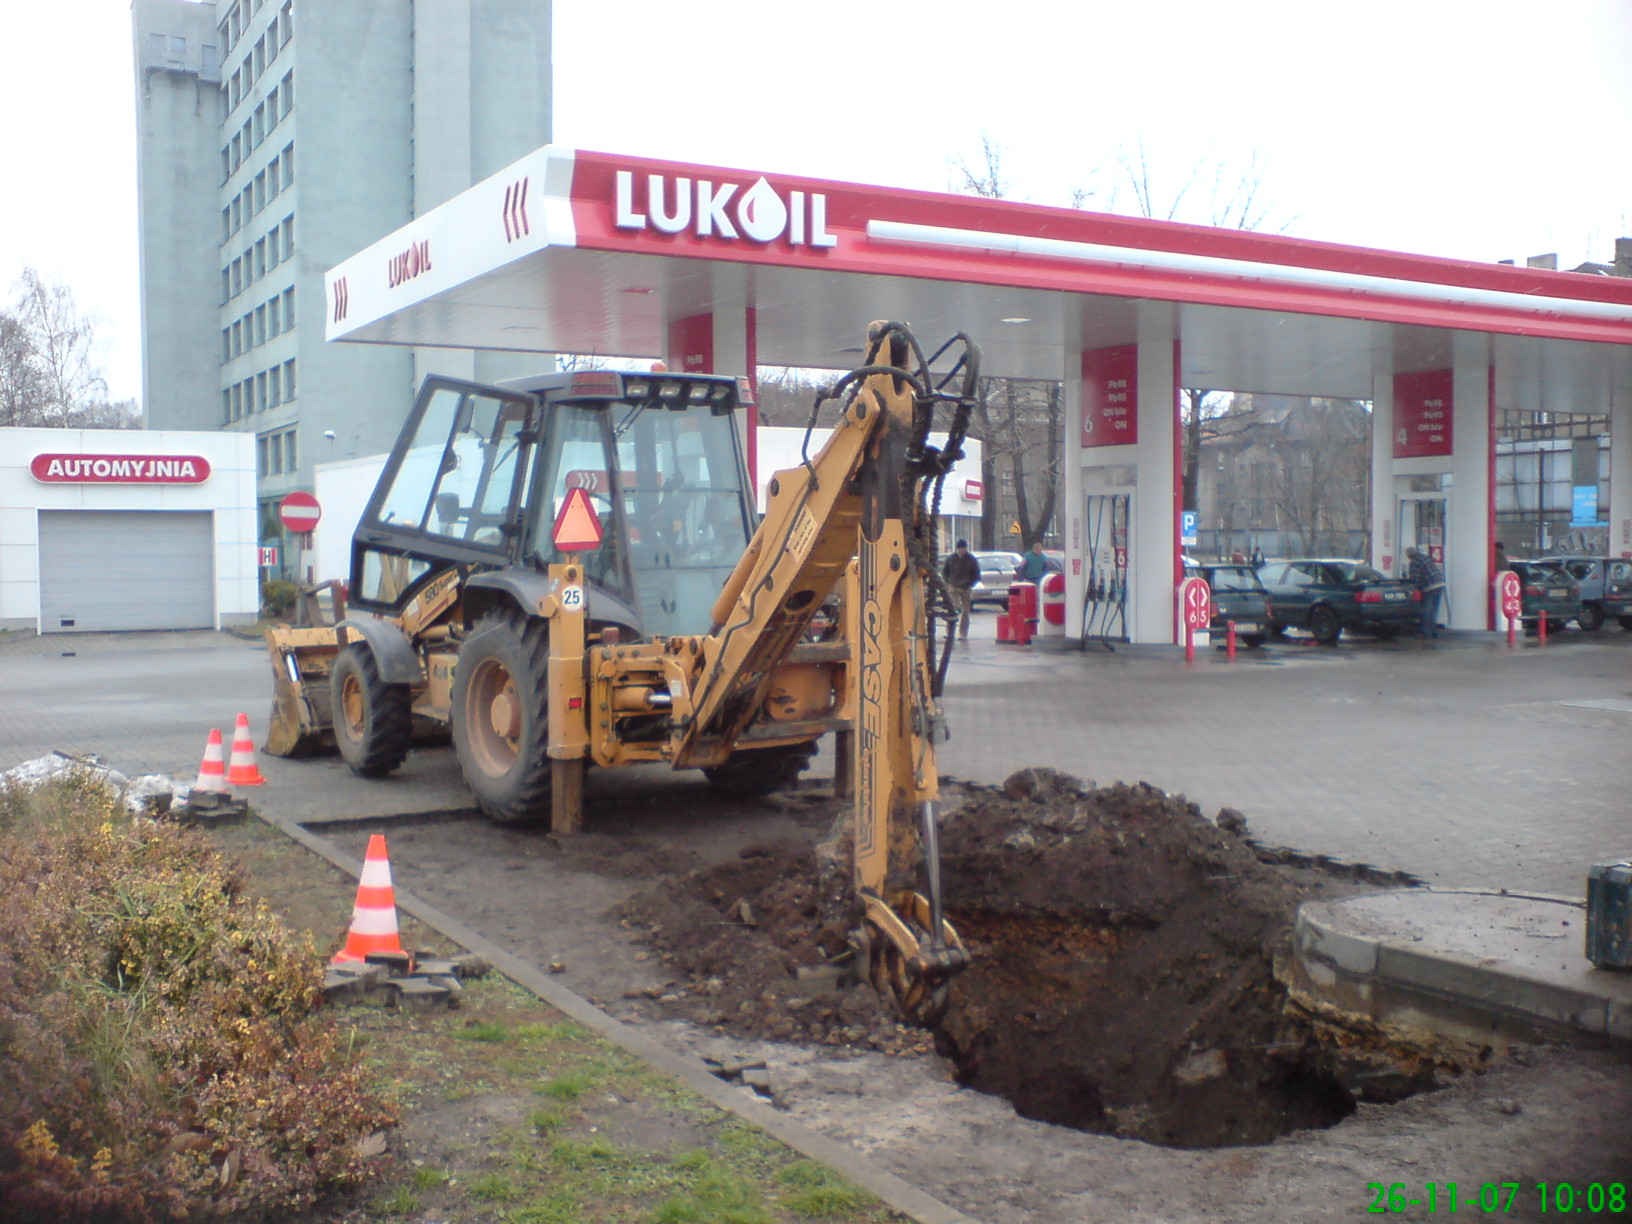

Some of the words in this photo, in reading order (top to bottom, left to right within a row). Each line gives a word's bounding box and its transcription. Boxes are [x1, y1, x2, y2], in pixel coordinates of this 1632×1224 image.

[616, 170, 837, 247] LUKOIL
[389, 239, 431, 288] LUKOIL
[1085, 414, 1094, 433] 6
[47, 459, 196, 477] AUTOMYJNIA
[1184, 514, 1194, 530] P
[264, 549, 271, 563] H
[1118, 551, 1125, 565] 6
[564, 590, 580, 604] 25
[1190, 611, 1197, 623] 6
[1200, 611, 1207, 622] 5
[864, 599, 882, 739] CASE
